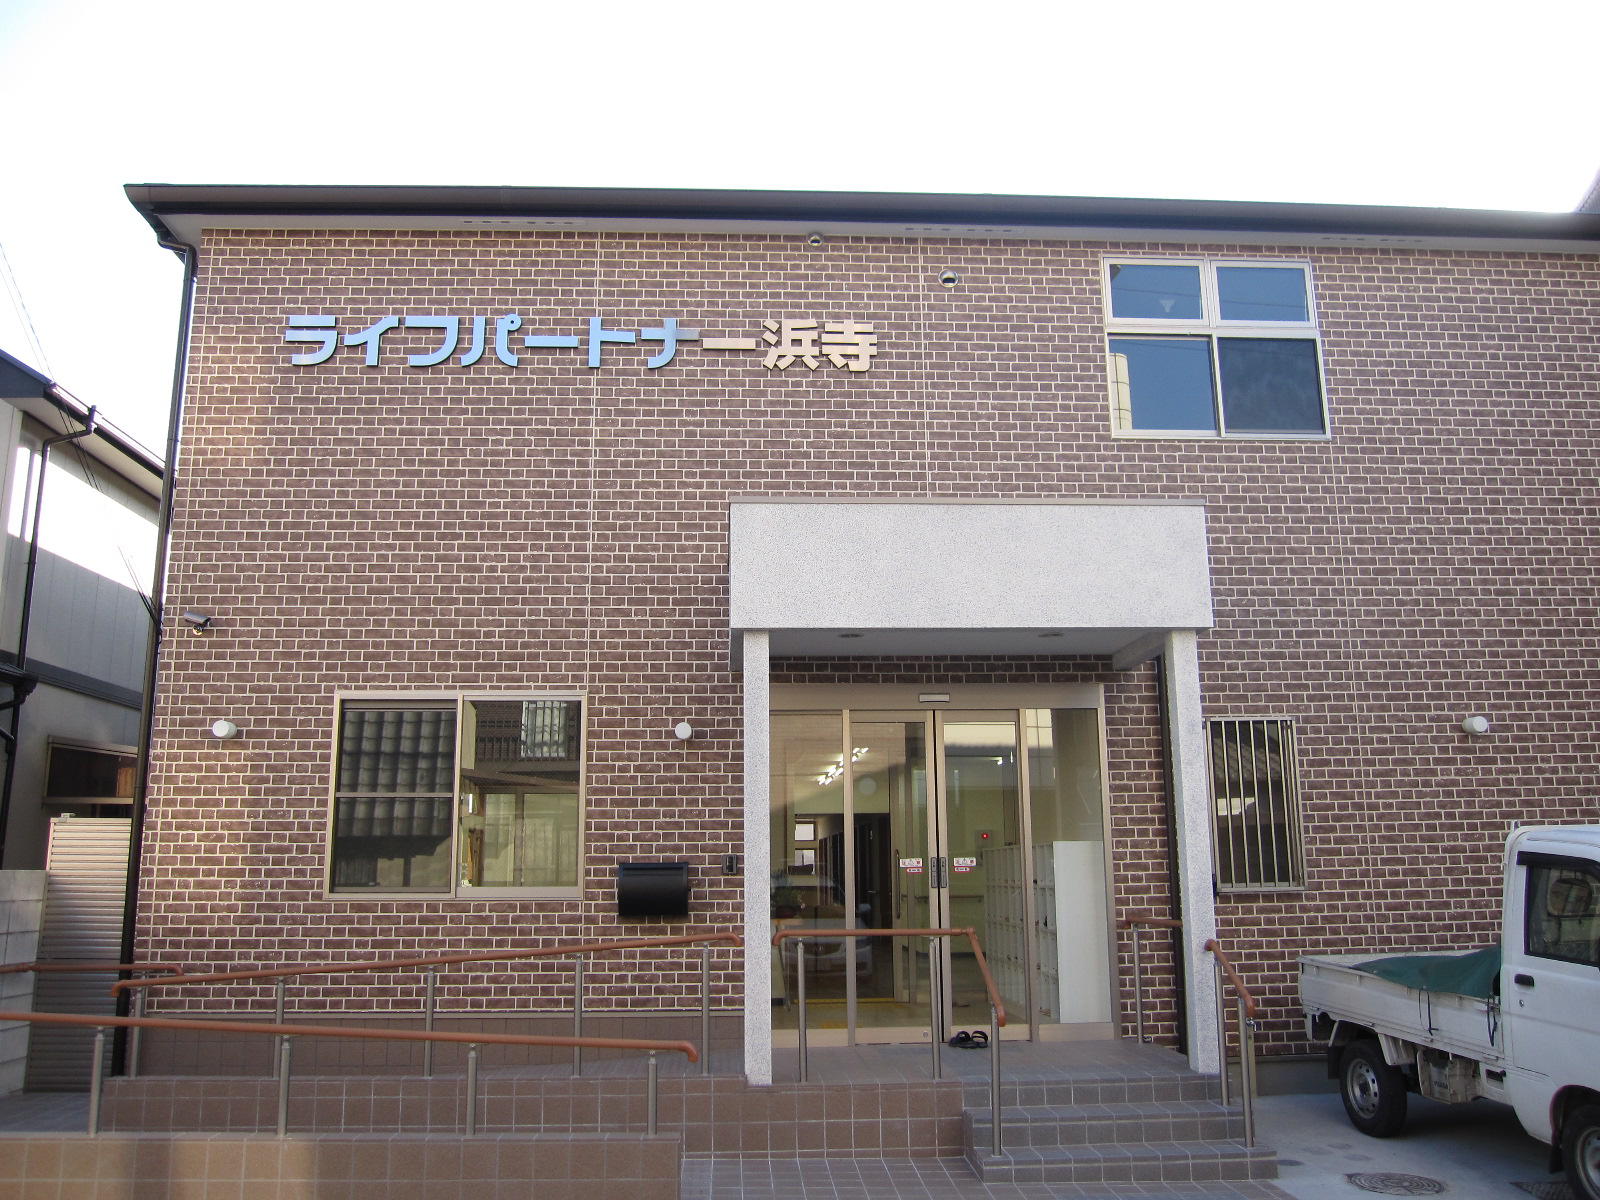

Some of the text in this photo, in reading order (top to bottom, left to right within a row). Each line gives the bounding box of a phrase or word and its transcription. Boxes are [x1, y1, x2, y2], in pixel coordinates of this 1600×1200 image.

[285, 313, 878, 372] ライフパートナー浜寺
